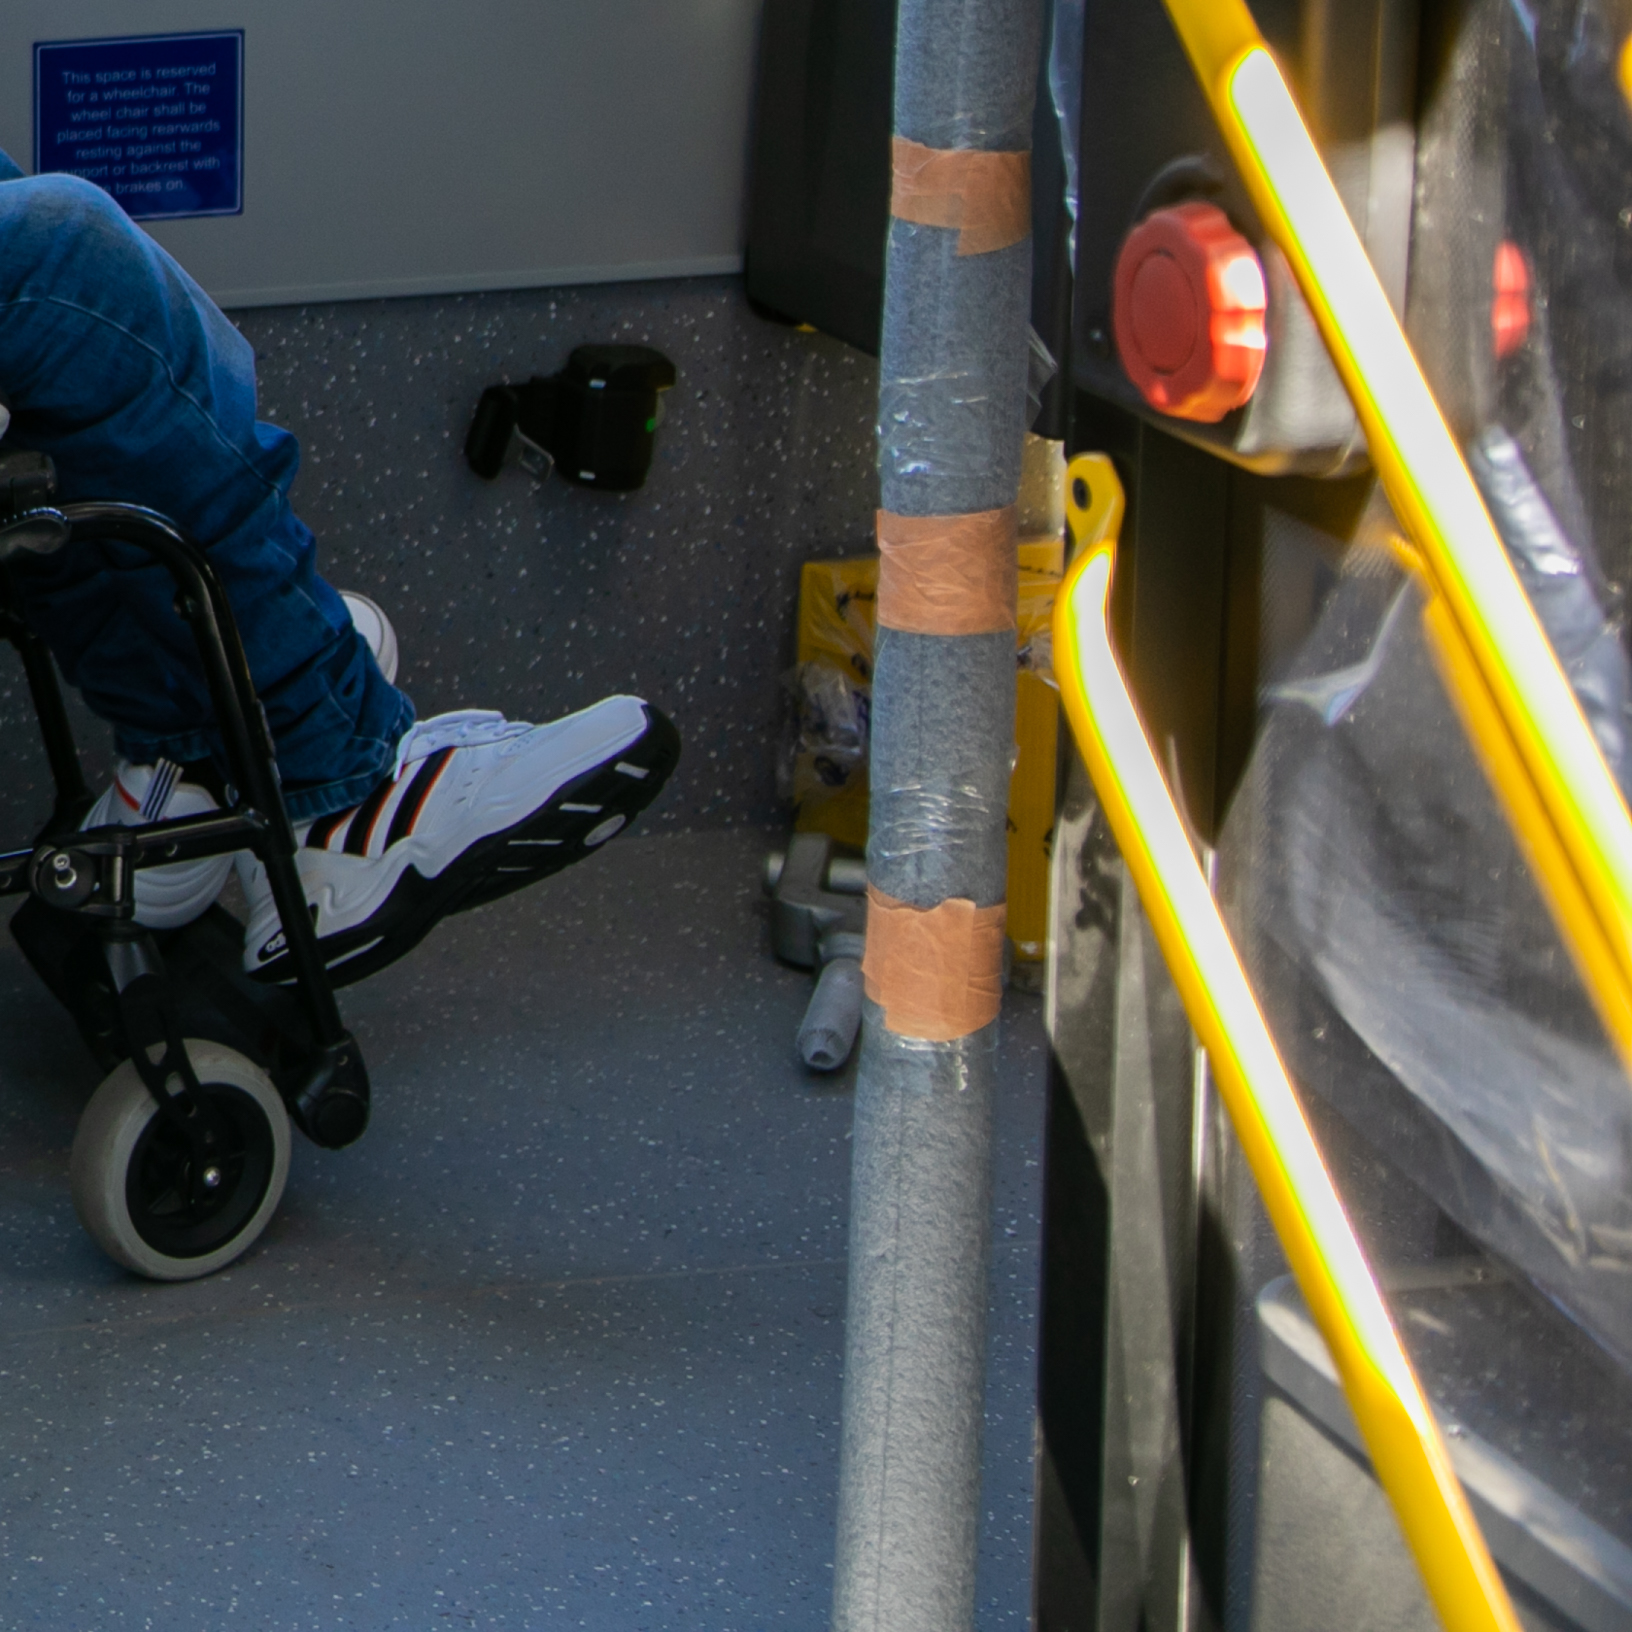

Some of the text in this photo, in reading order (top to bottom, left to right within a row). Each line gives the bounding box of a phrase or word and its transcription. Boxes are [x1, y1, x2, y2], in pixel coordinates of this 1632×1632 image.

[62, 63, 216, 85] This space is reserved
[67, 90, 85, 103] for
[90, 90, 98, 102] a
[184, 82, 210, 96] The
[71, 101, 207, 122] wheel chair shall be
[56, 120, 221, 144] placed facing rearwards
[76, 140, 202, 160] resting against the
[113, 164, 126, 177] or
[131, 159, 189, 175] backrest
[193, 156, 221, 170] with
[116, 179, 162, 194] brakes
